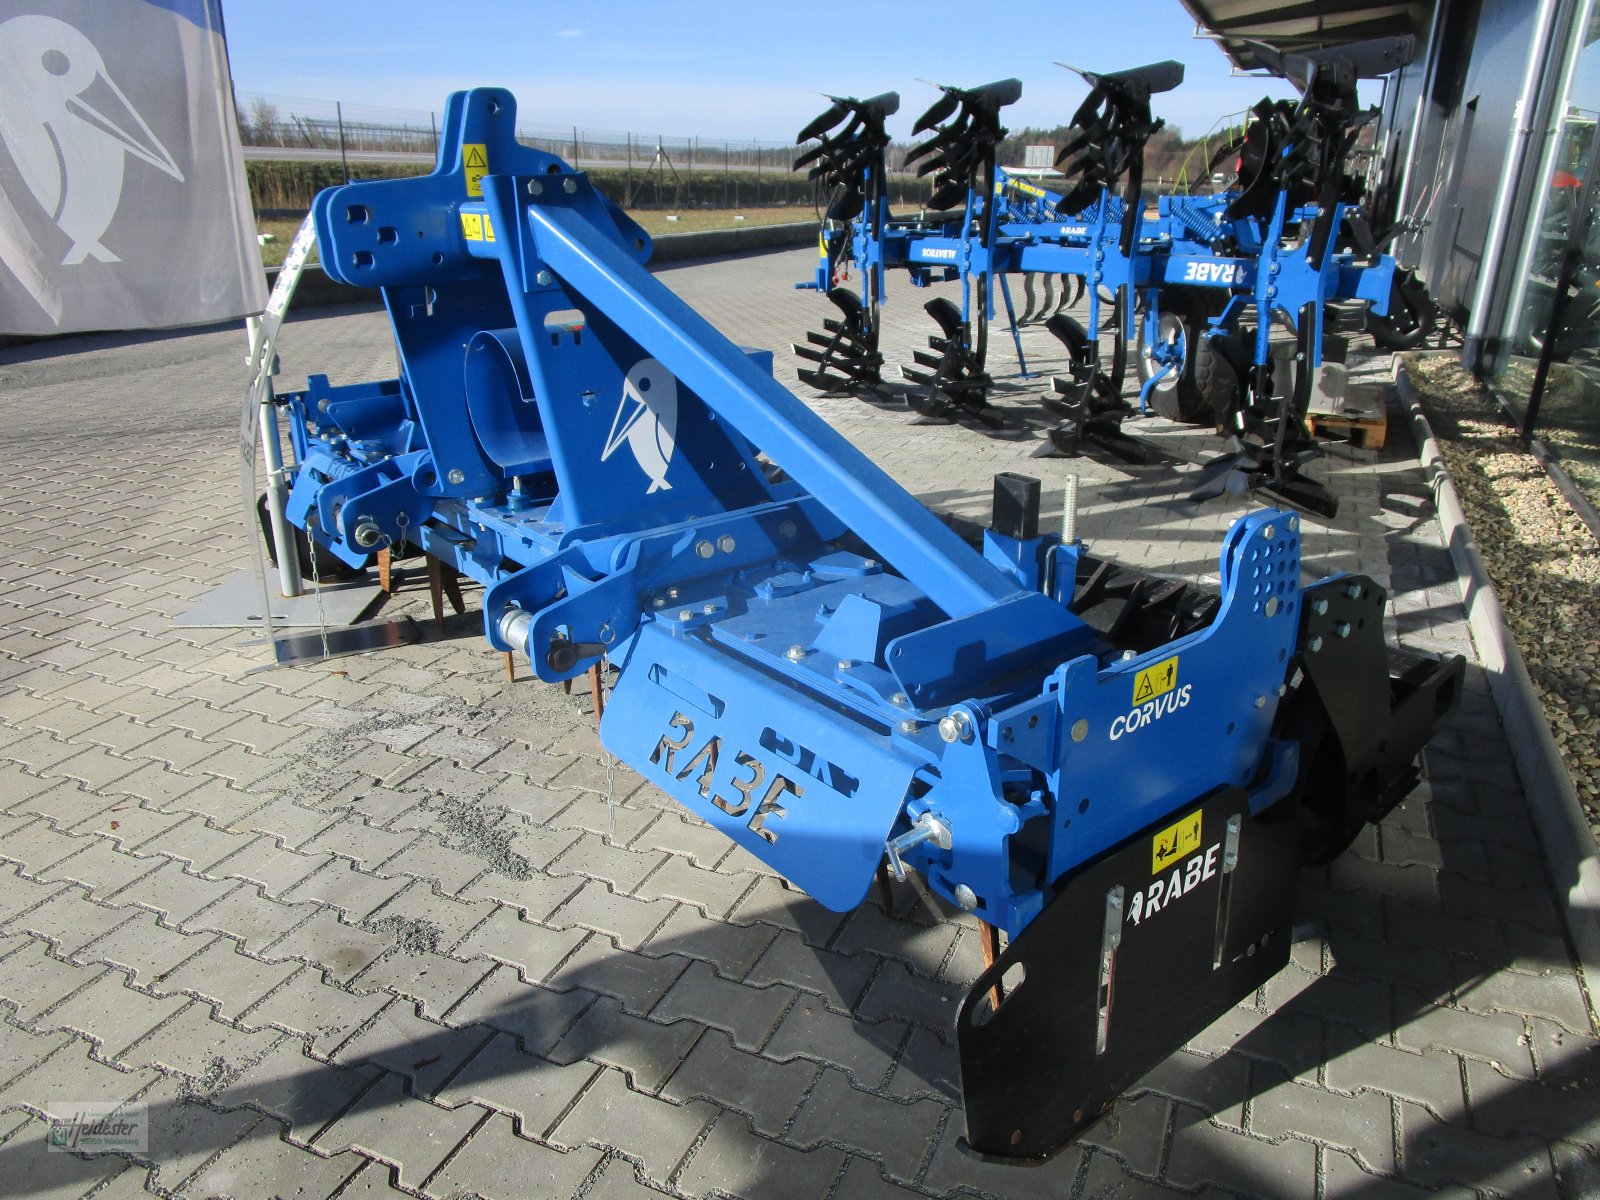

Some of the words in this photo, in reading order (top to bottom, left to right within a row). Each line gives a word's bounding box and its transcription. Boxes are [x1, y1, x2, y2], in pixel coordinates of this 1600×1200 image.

[1065, 226, 1088, 235] RABE
[1184, 261, 1236, 283] RABE
[1109, 683, 1192, 741] CORVUS
[649, 710, 805, 845] RABE
[1145, 842, 1221, 919] RABE
